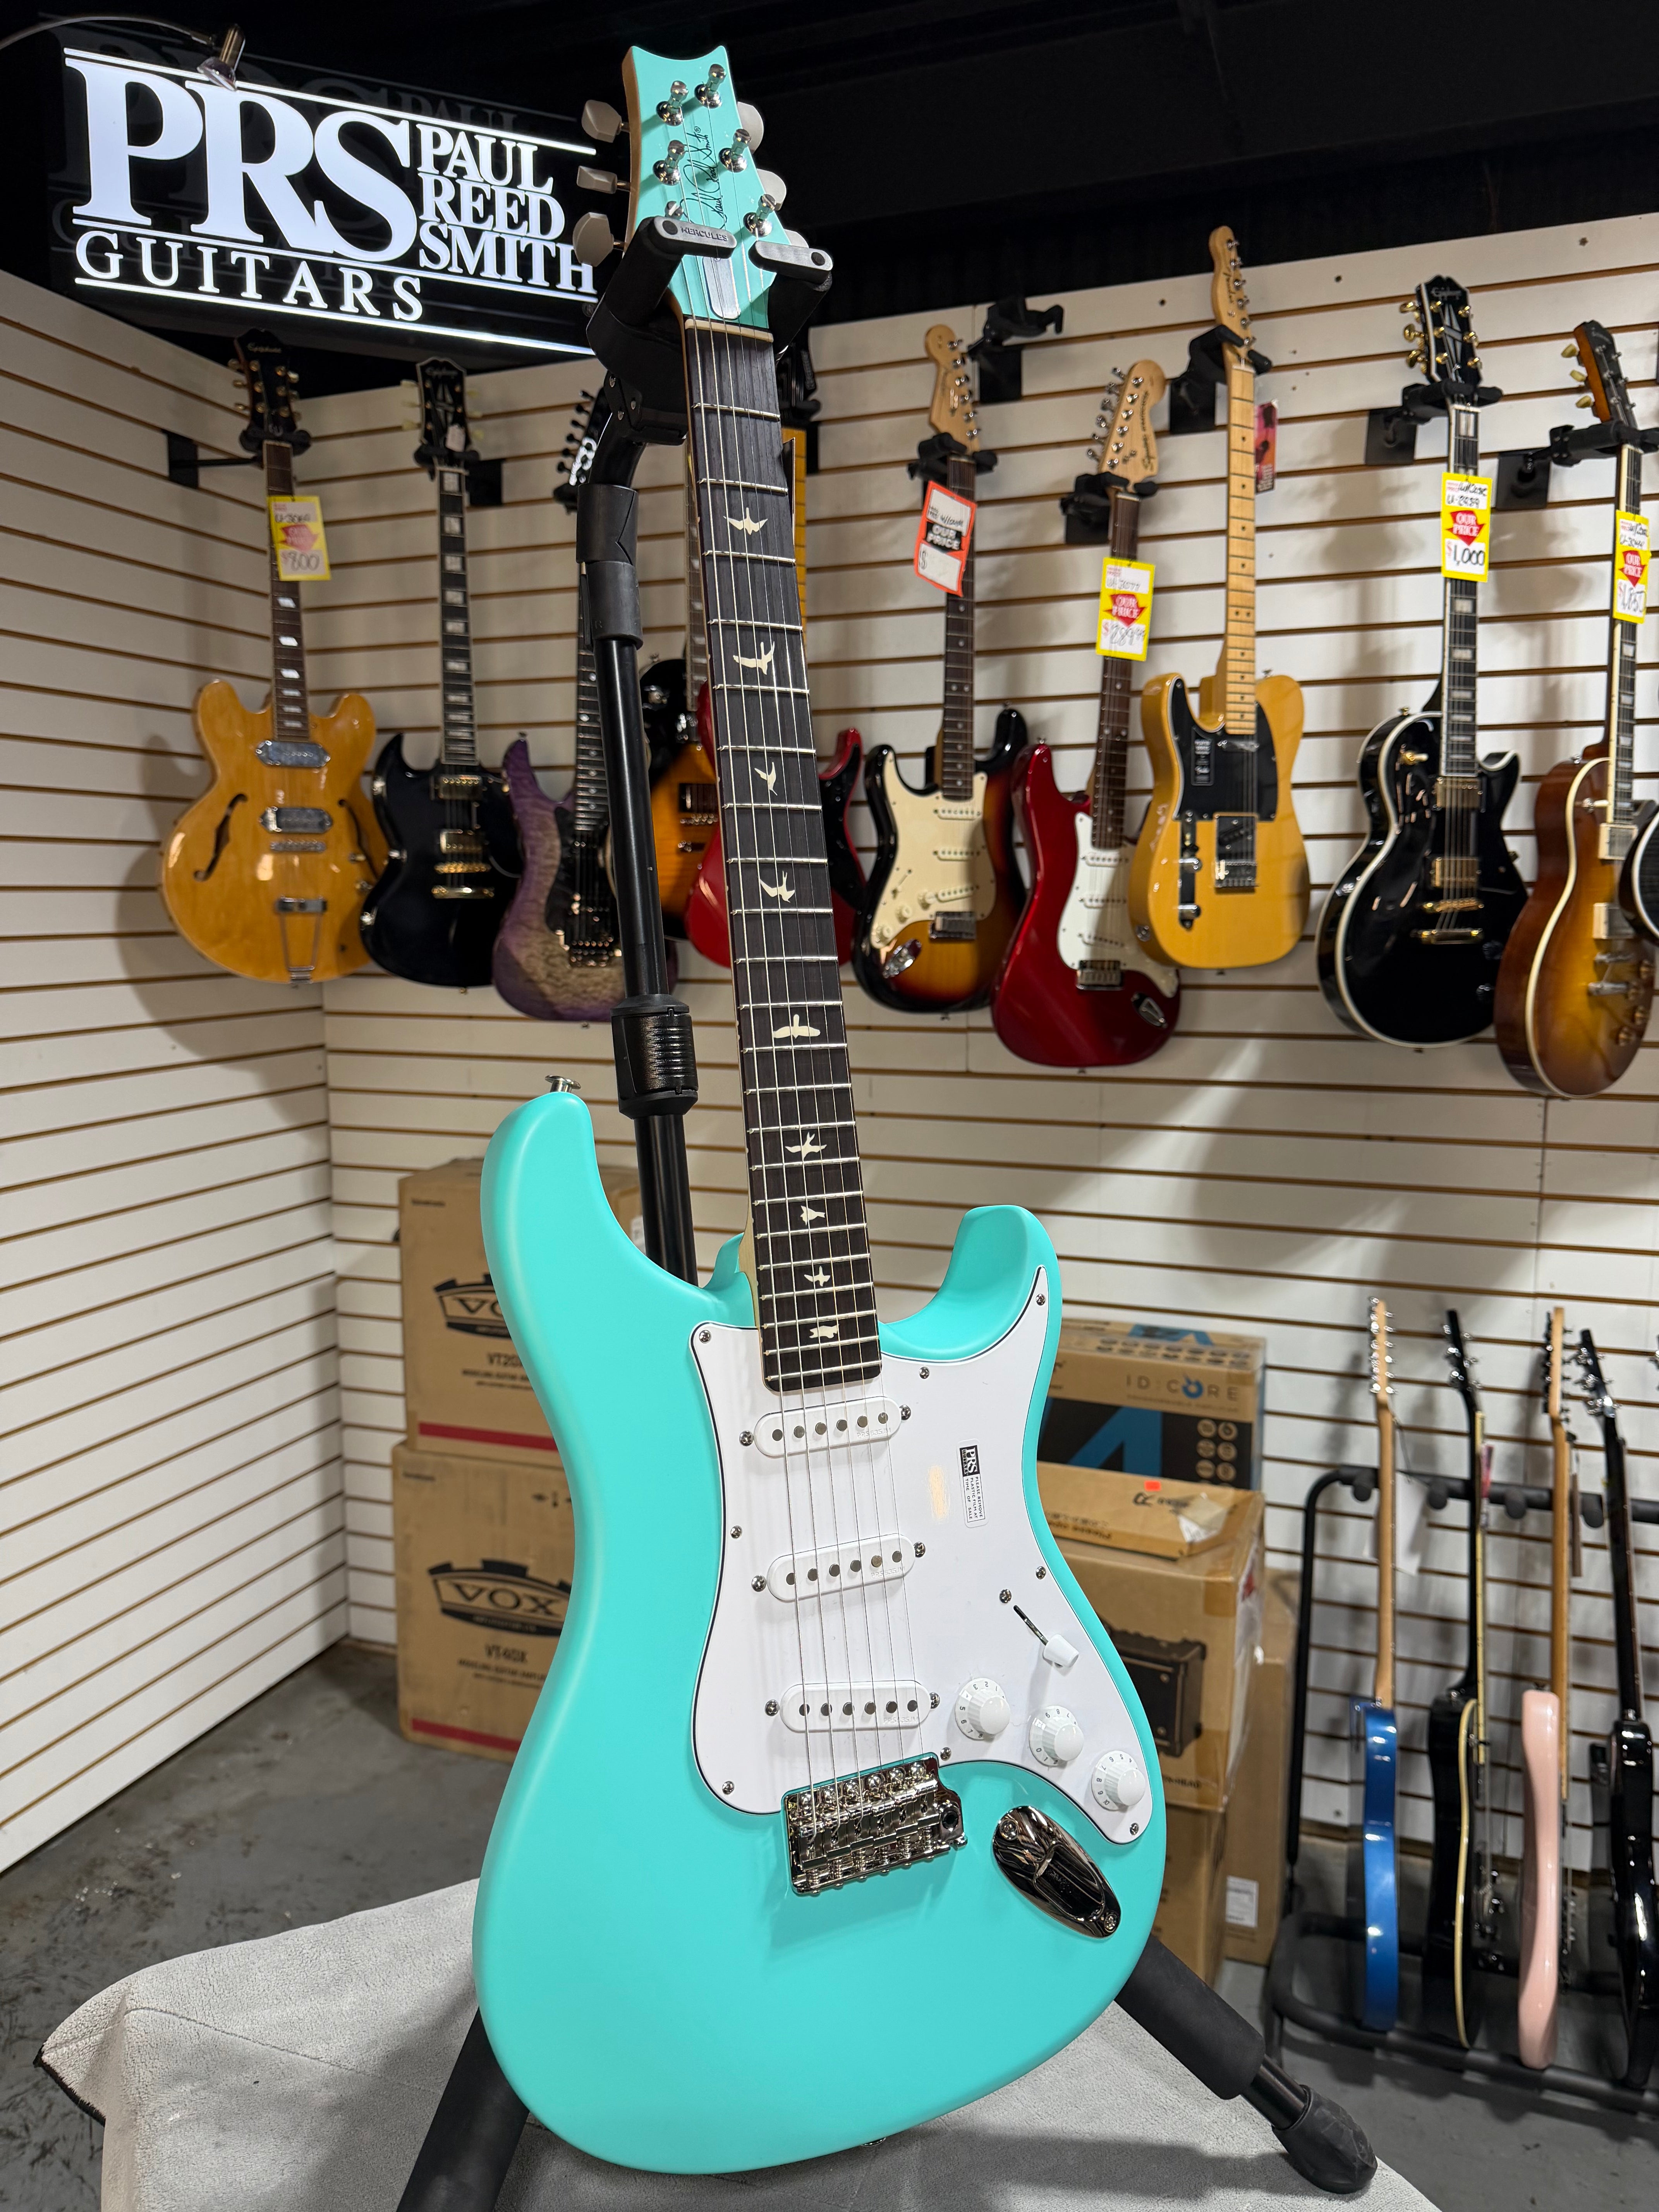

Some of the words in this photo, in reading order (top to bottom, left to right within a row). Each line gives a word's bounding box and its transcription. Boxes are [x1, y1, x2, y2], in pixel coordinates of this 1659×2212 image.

[65, 57, 417, 262] PRS
[416, 124, 553, 194] PAUL
[418, 173, 565, 240] REED
[680, 226, 728, 242] HERCULES
[419, 221, 598, 294] SMITH
[76, 231, 423, 321] GUITARS
[1456, 512, 1476, 525] OUR
[932, 523, 957, 539] OUR
[1453, 524, 1480, 537] PRICE
[926, 532, 961, 550] PRICE
[1626, 552, 1641, 565] OUR
[1623, 564, 1642, 577] PRICE
[1115, 594, 1137, 608] OUR
[966, 1447, 978, 1473] PRS
[450, 1580, 562, 1618] VOX
